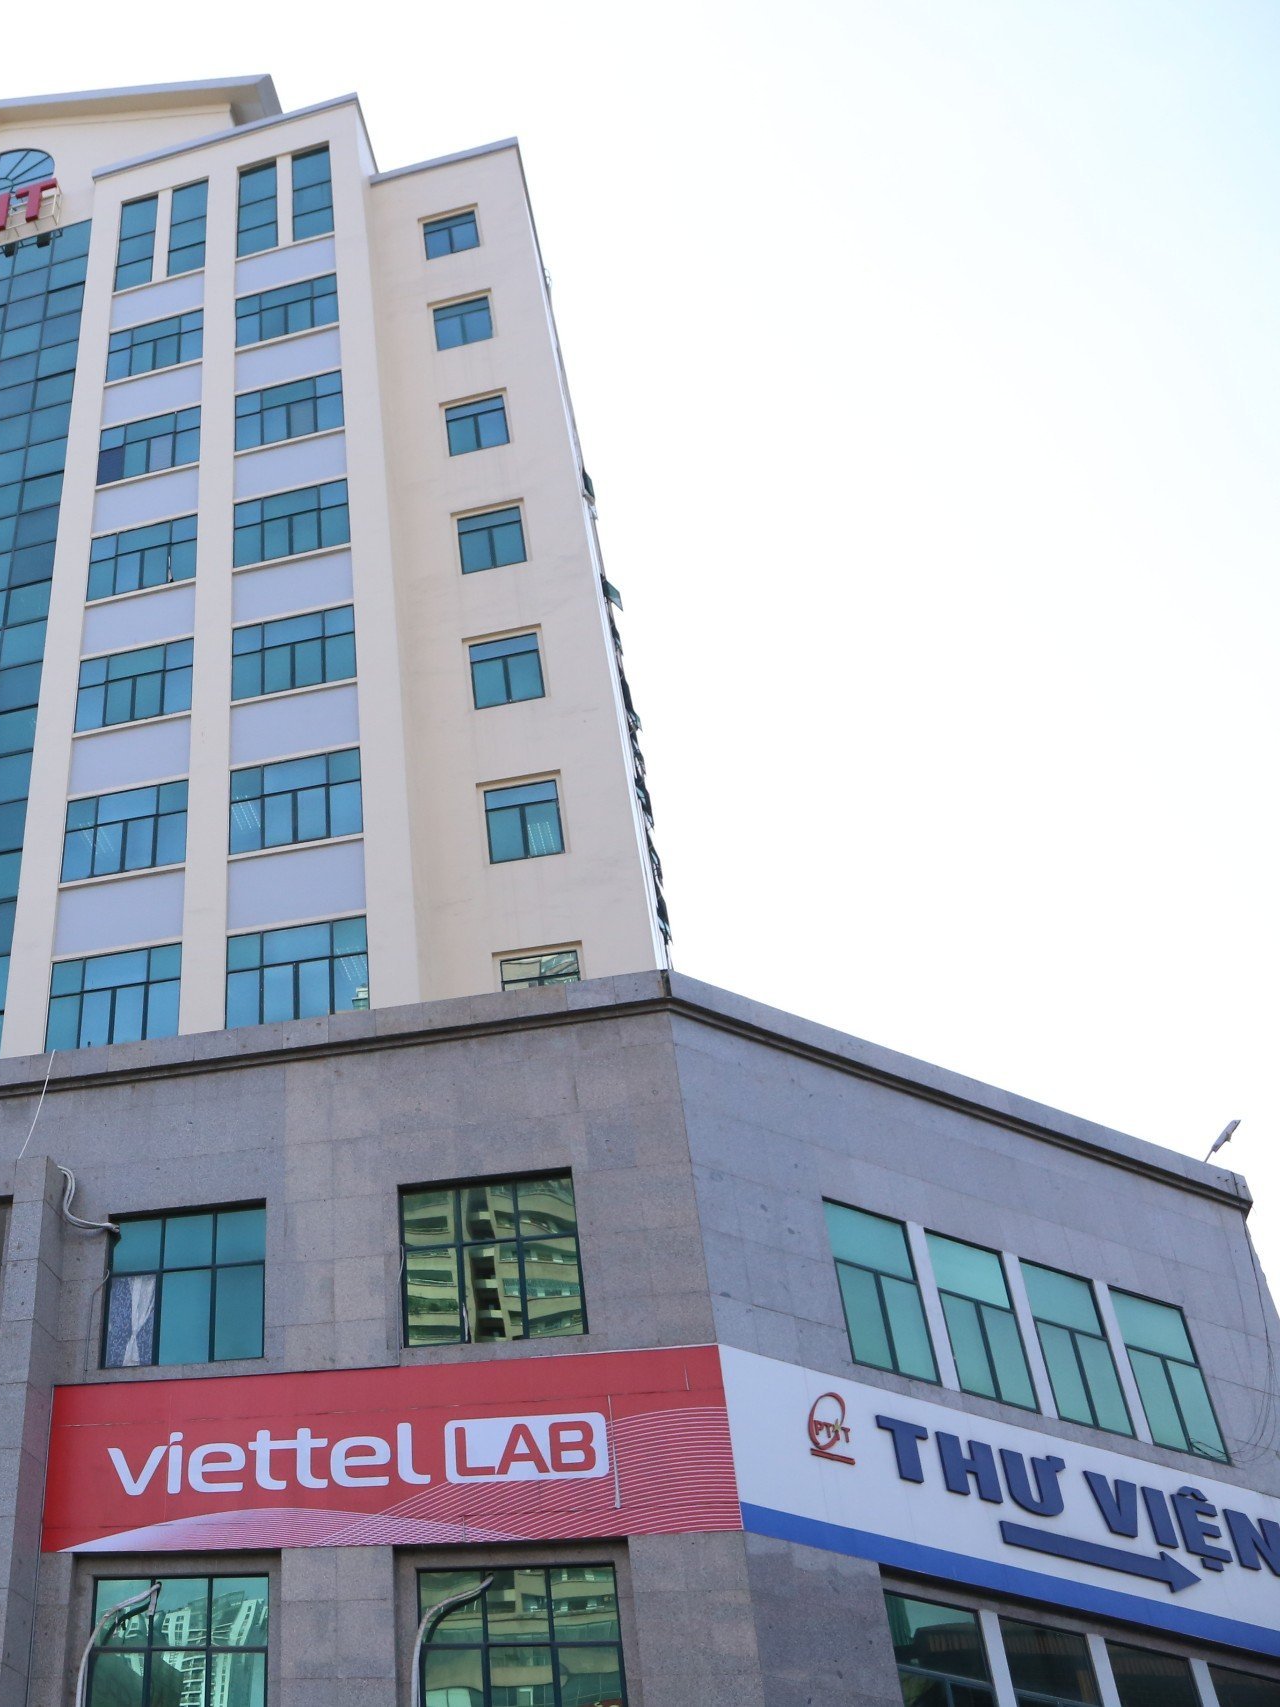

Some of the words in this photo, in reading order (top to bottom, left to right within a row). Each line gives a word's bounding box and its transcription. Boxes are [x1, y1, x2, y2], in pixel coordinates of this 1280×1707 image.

[107, 1422, 431, 1496] viettel
[454, 1421, 597, 1476] LAB
[875, 1414, 1066, 1517] THƯ
[1082, 1470, 1280, 1577] VIỆN
